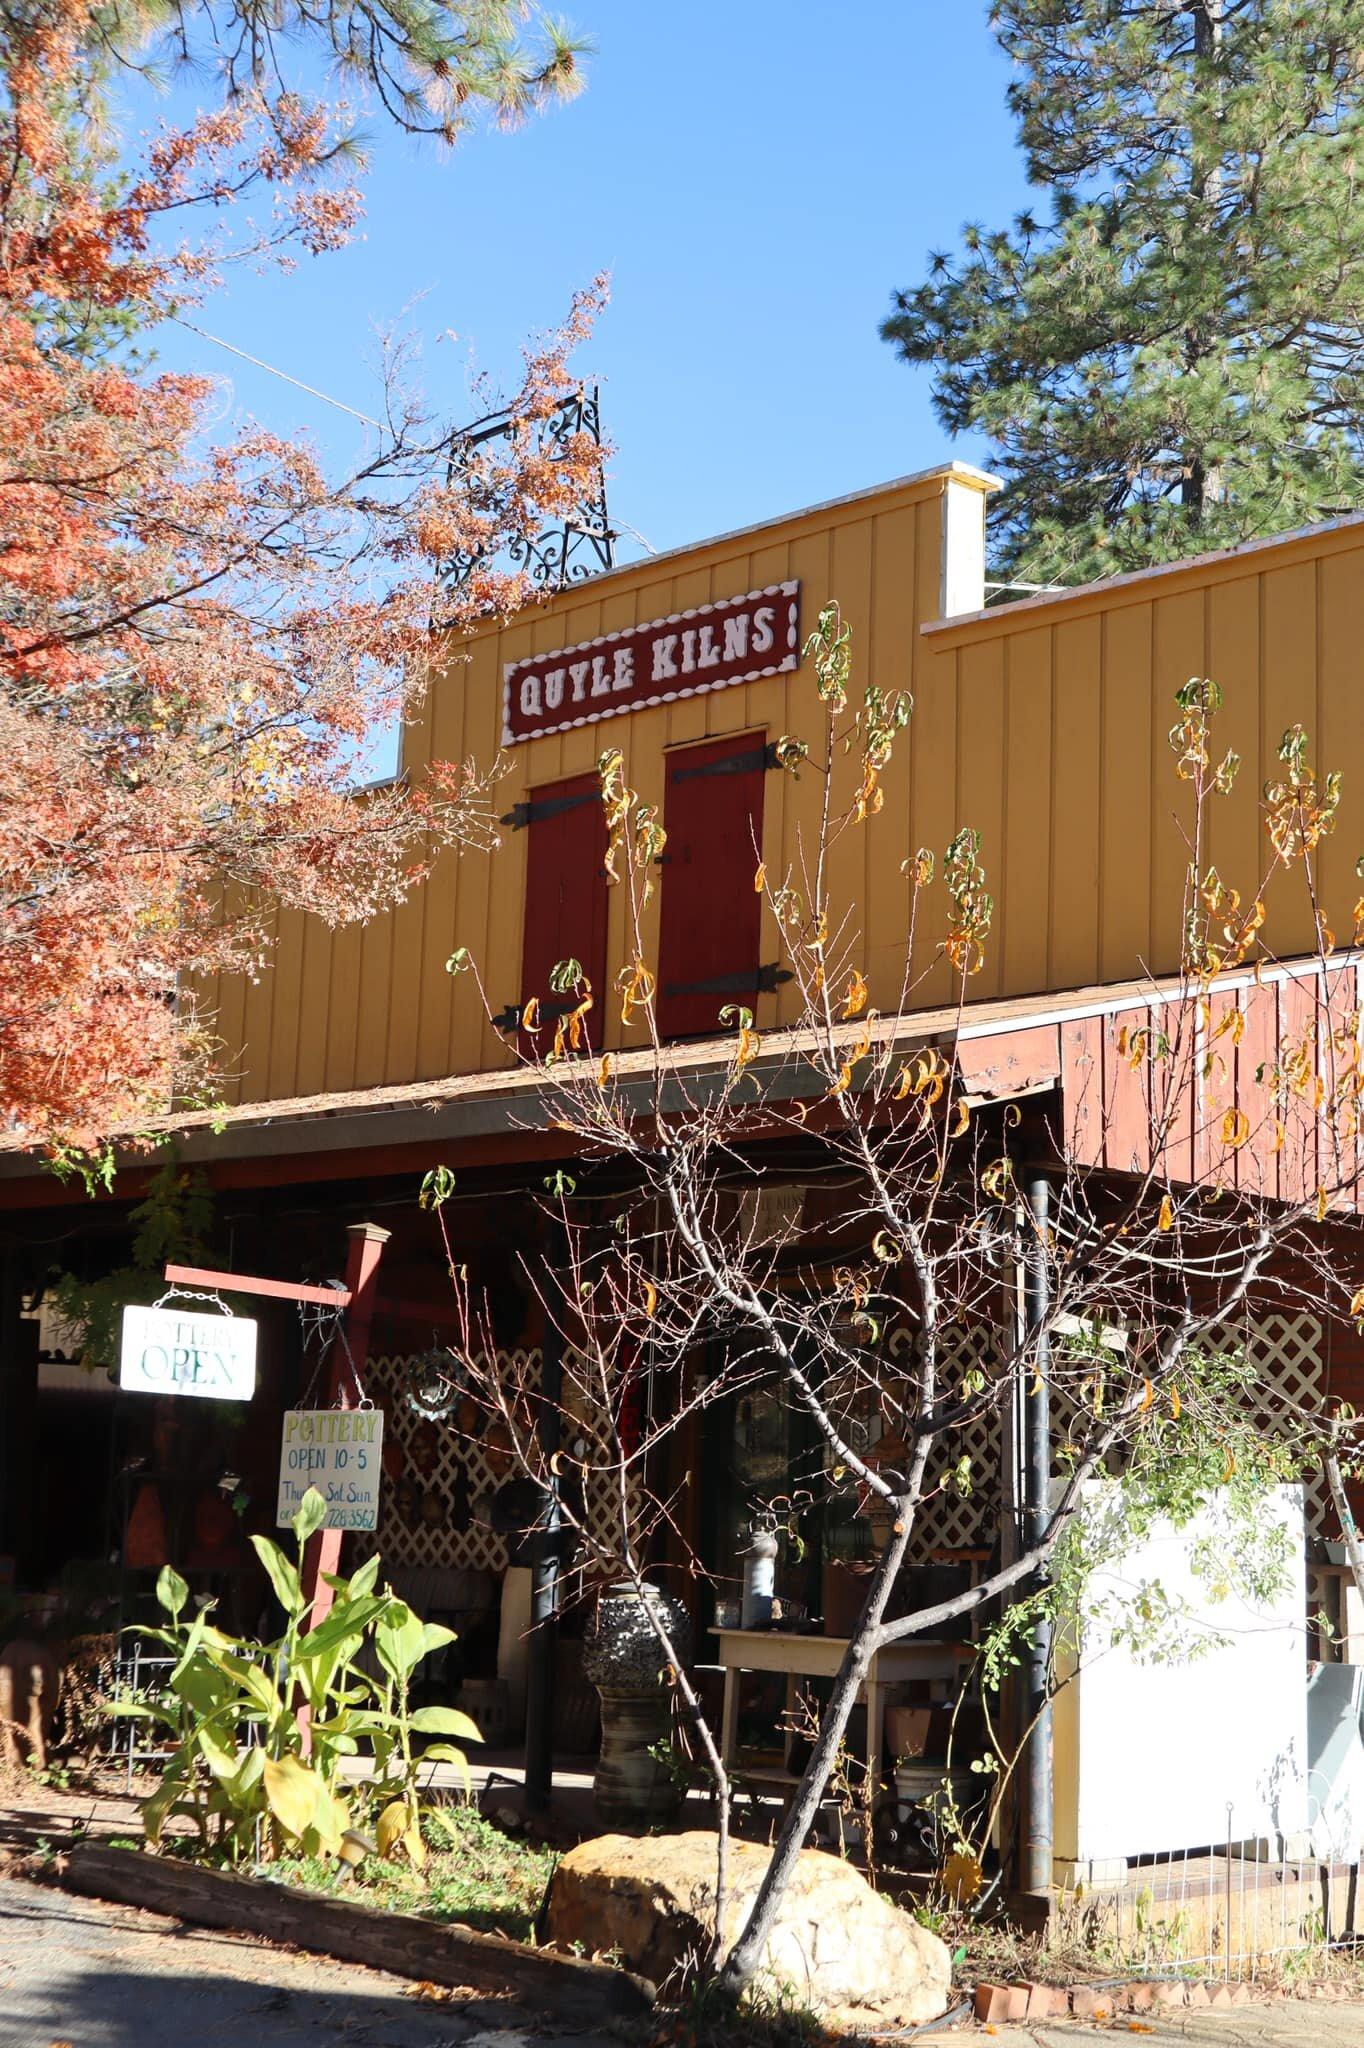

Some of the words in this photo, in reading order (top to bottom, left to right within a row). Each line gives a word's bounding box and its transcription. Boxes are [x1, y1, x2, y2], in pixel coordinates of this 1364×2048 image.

[520, 647, 635, 716] QUYLE
[651, 607, 776, 681] KILNS
[143, 1319, 237, 1348] POTTERY
[141, 1345, 237, 1385] OPEN
[285, 1413, 379, 1443] POTTERY
[288, 1448, 326, 1470] OPEN
[325, 1481, 345, 1502] Sat
[347, 1481, 371, 1503] Sun
